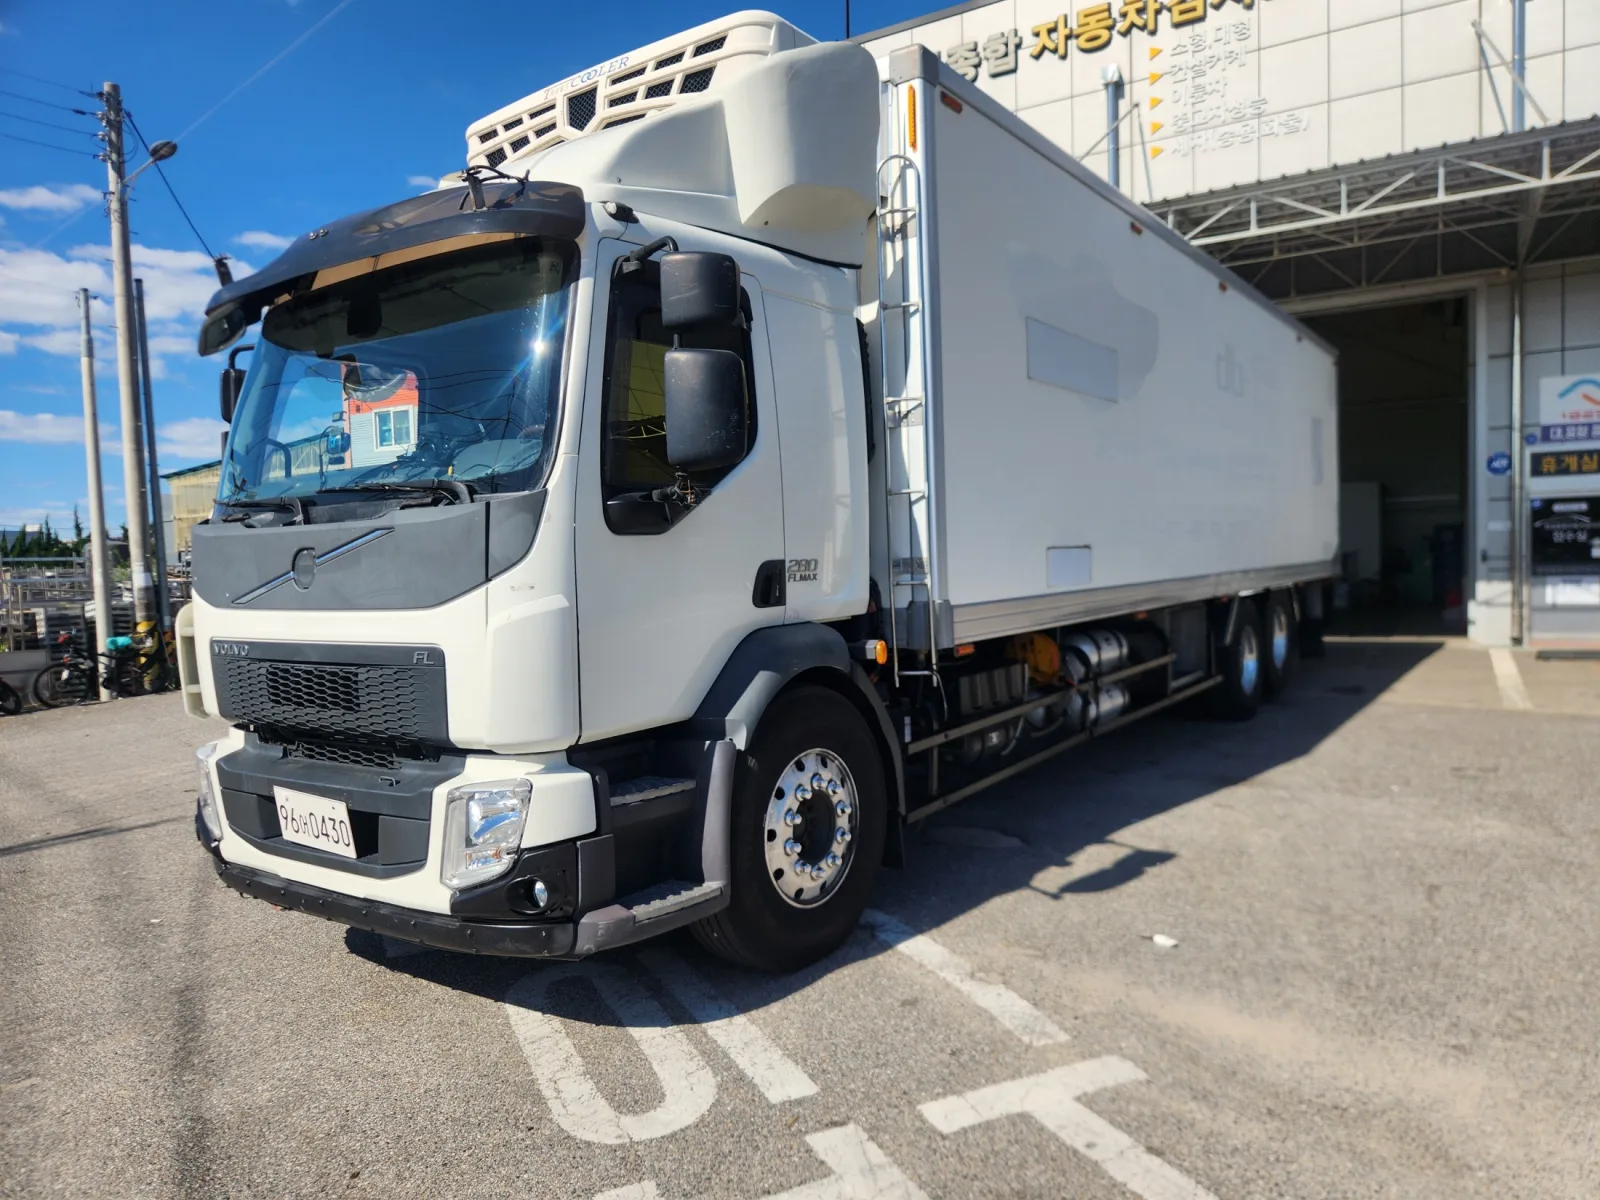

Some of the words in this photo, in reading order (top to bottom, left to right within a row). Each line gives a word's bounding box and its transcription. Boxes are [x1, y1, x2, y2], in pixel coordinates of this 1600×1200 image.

[787, 558, 818, 573] 280
[213, 643, 249, 656] VOLVO
[412, 651, 436, 665] FL
